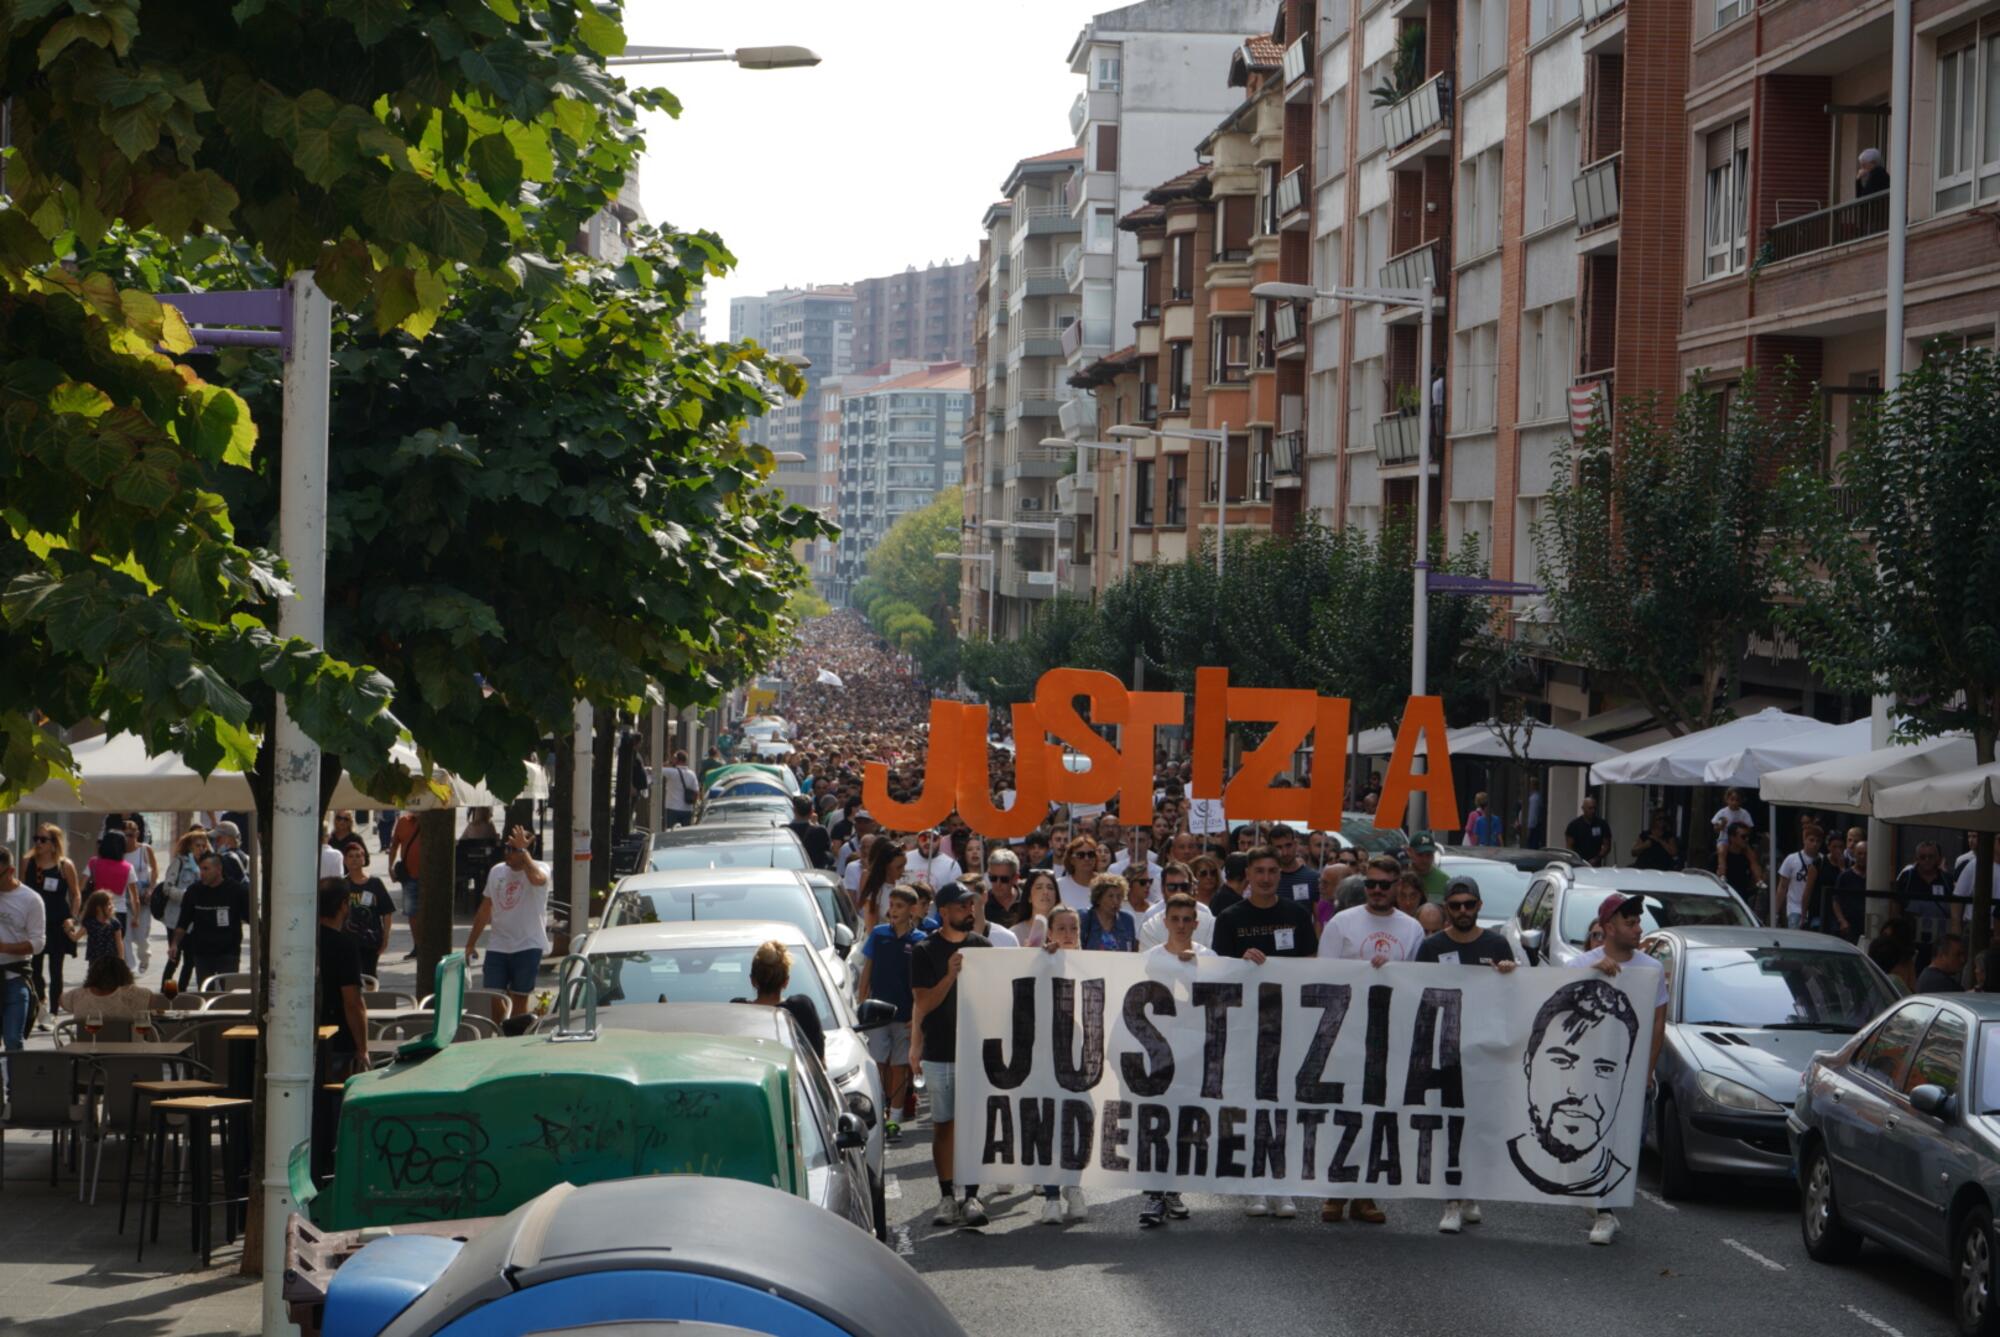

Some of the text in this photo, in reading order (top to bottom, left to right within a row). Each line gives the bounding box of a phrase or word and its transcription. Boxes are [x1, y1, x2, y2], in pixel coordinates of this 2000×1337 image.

[862, 666, 1460, 838] JUSTIZIA
[982, 976, 1465, 1108] JUSTIZIA
[982, 1094, 1466, 1187] ANDERRENTZAT!
